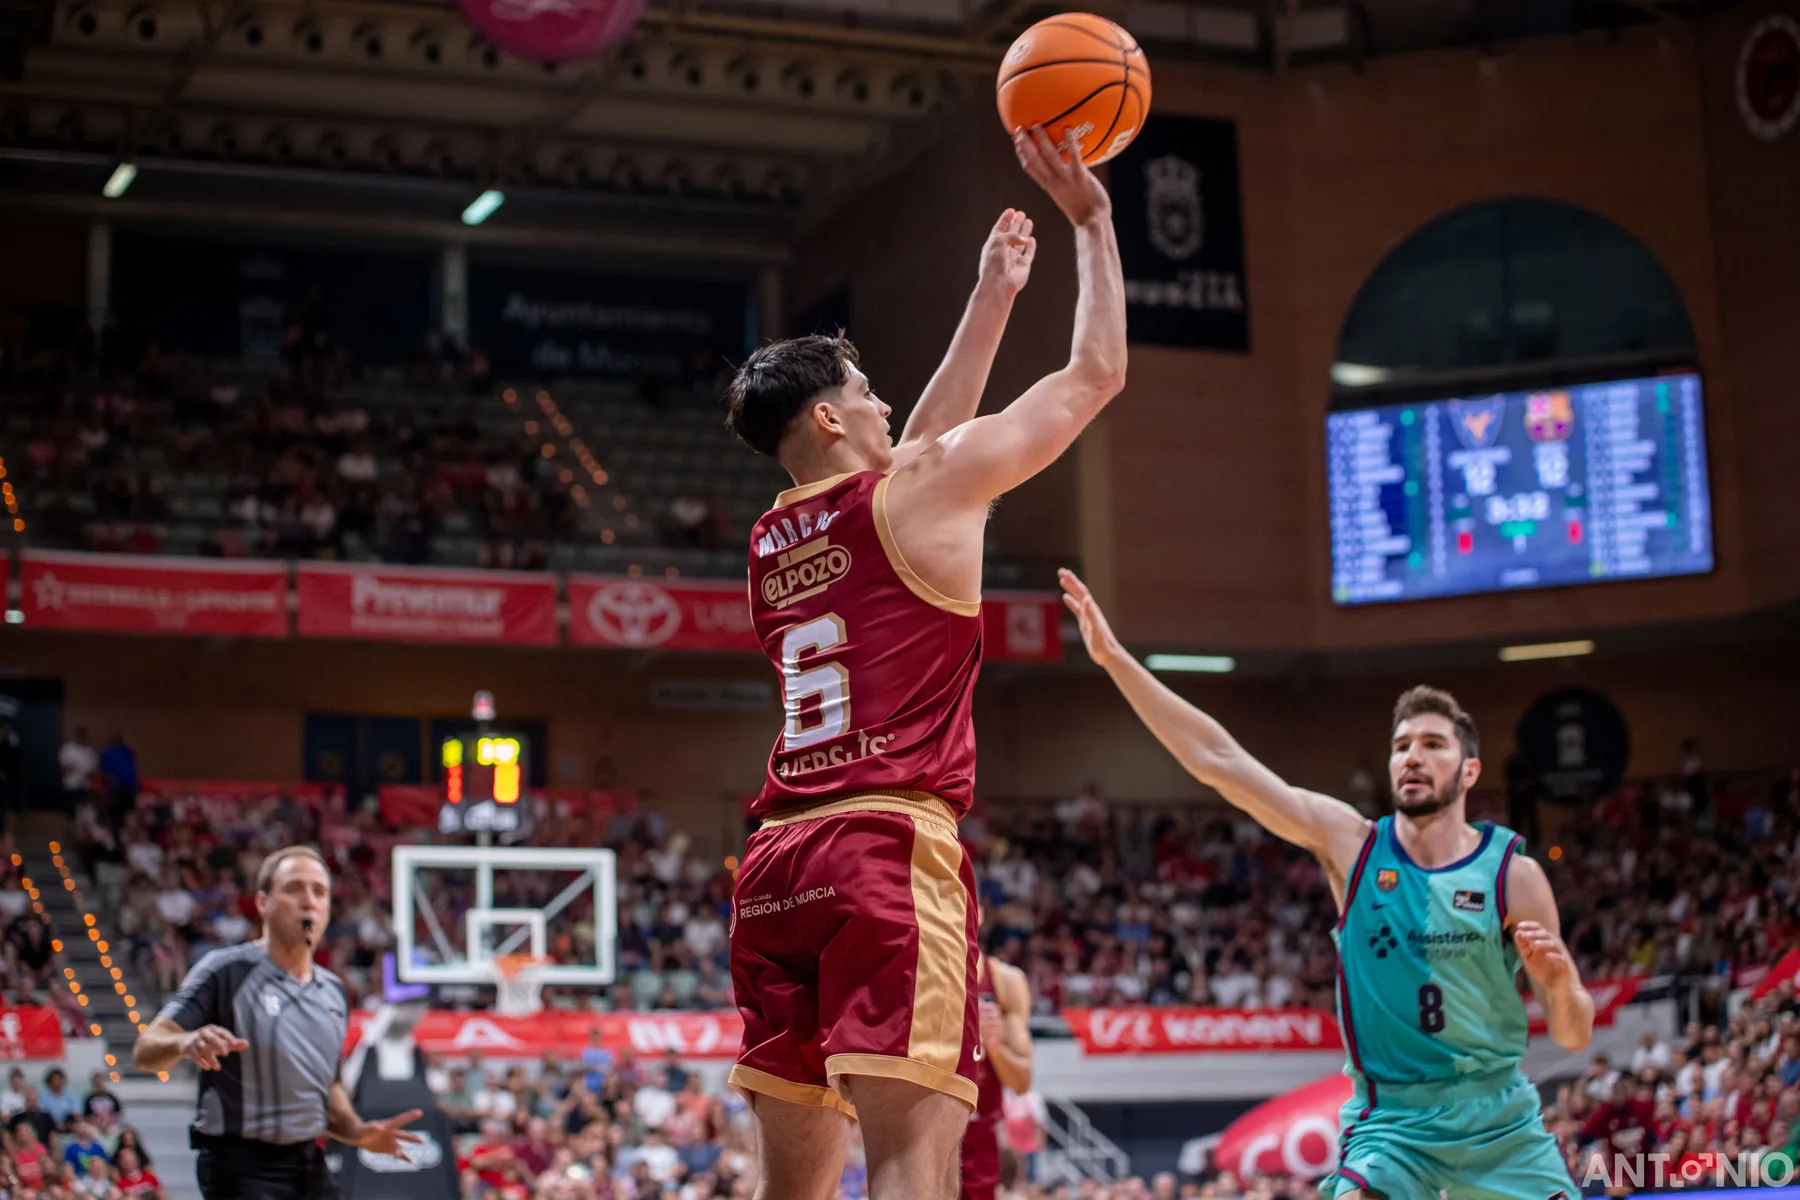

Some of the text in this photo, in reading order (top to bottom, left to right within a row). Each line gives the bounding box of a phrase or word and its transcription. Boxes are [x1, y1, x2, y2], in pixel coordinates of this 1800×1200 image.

[782, 611, 852, 752] 6
[740, 886, 836, 919] REGIÓN DE MURCIA
[1418, 982, 1445, 1034] 8
